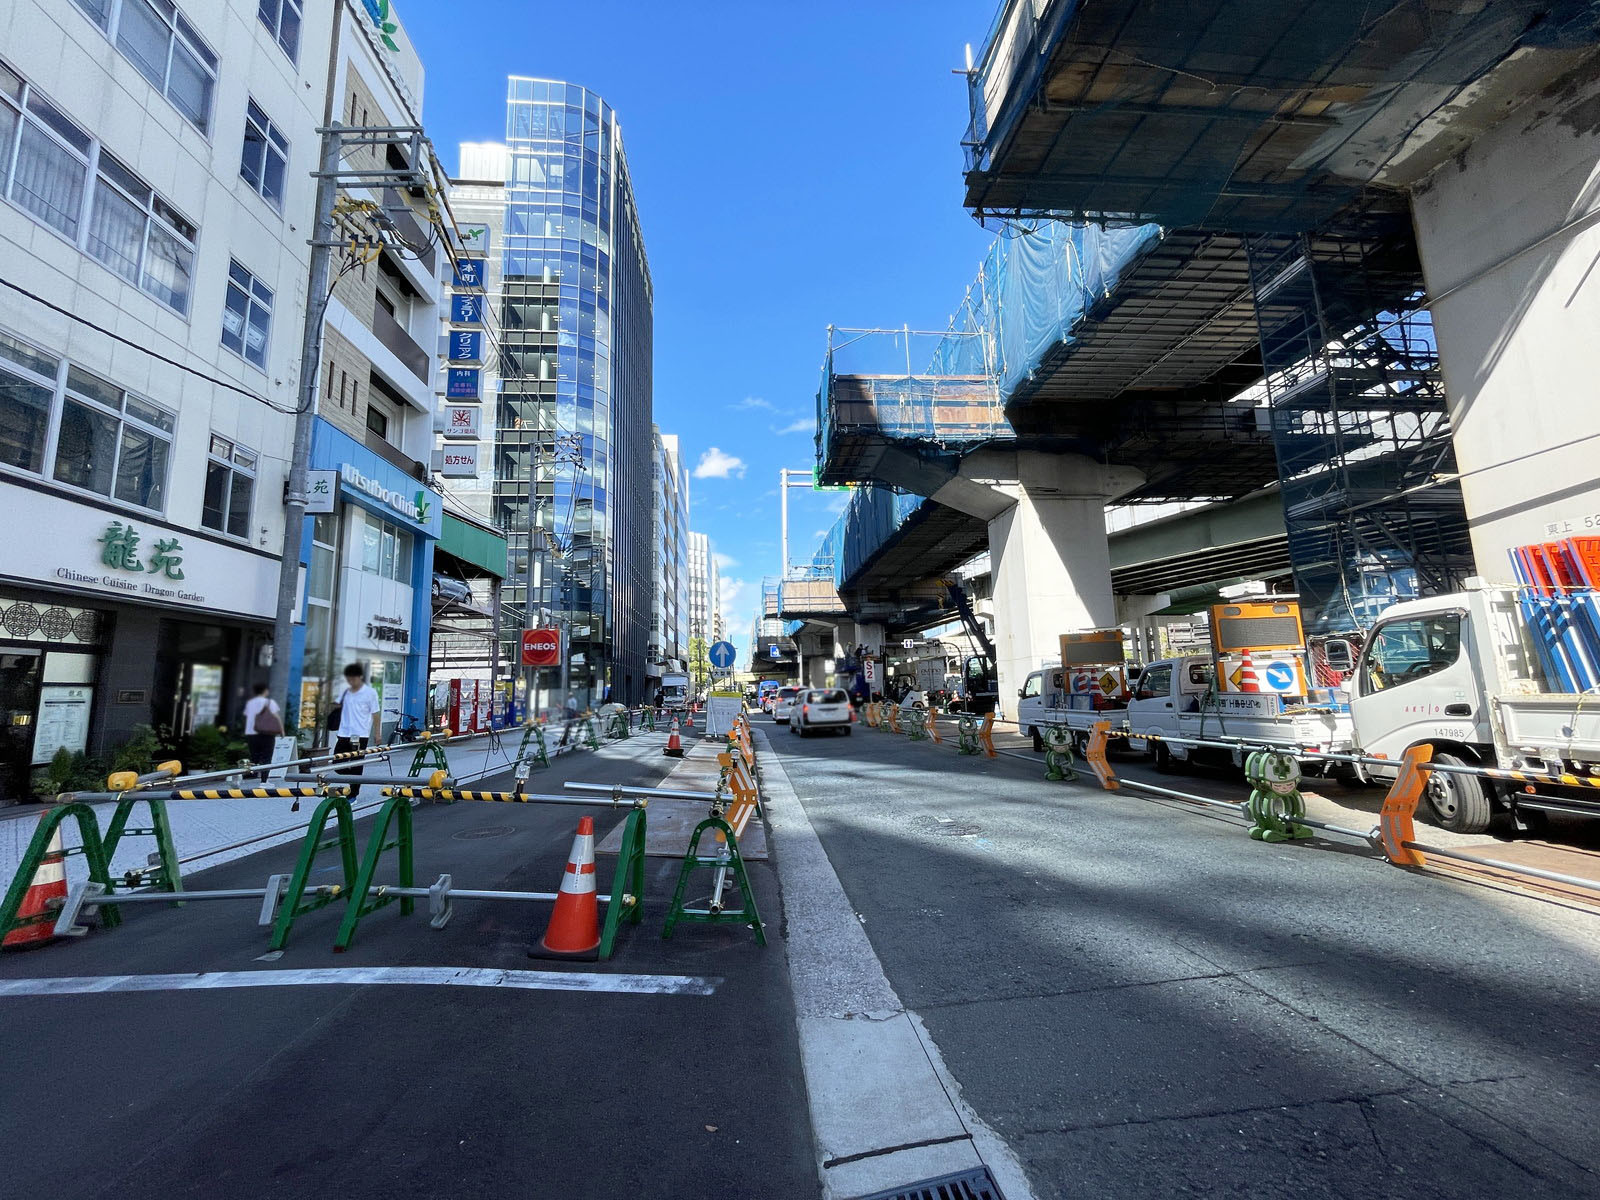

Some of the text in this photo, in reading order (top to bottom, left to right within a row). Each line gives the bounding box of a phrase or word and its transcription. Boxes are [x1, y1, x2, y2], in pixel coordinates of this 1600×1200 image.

[462, 263, 476, 283] 本町
[445, 455, 474, 465] 処方せん
[97, 521, 185, 580] 龍苑
[56, 567, 205, 603] Chinese Cuisine Dragon Garden
[524, 642, 557, 651] ENEOS
[1433, 728, 1465, 738] 147985
